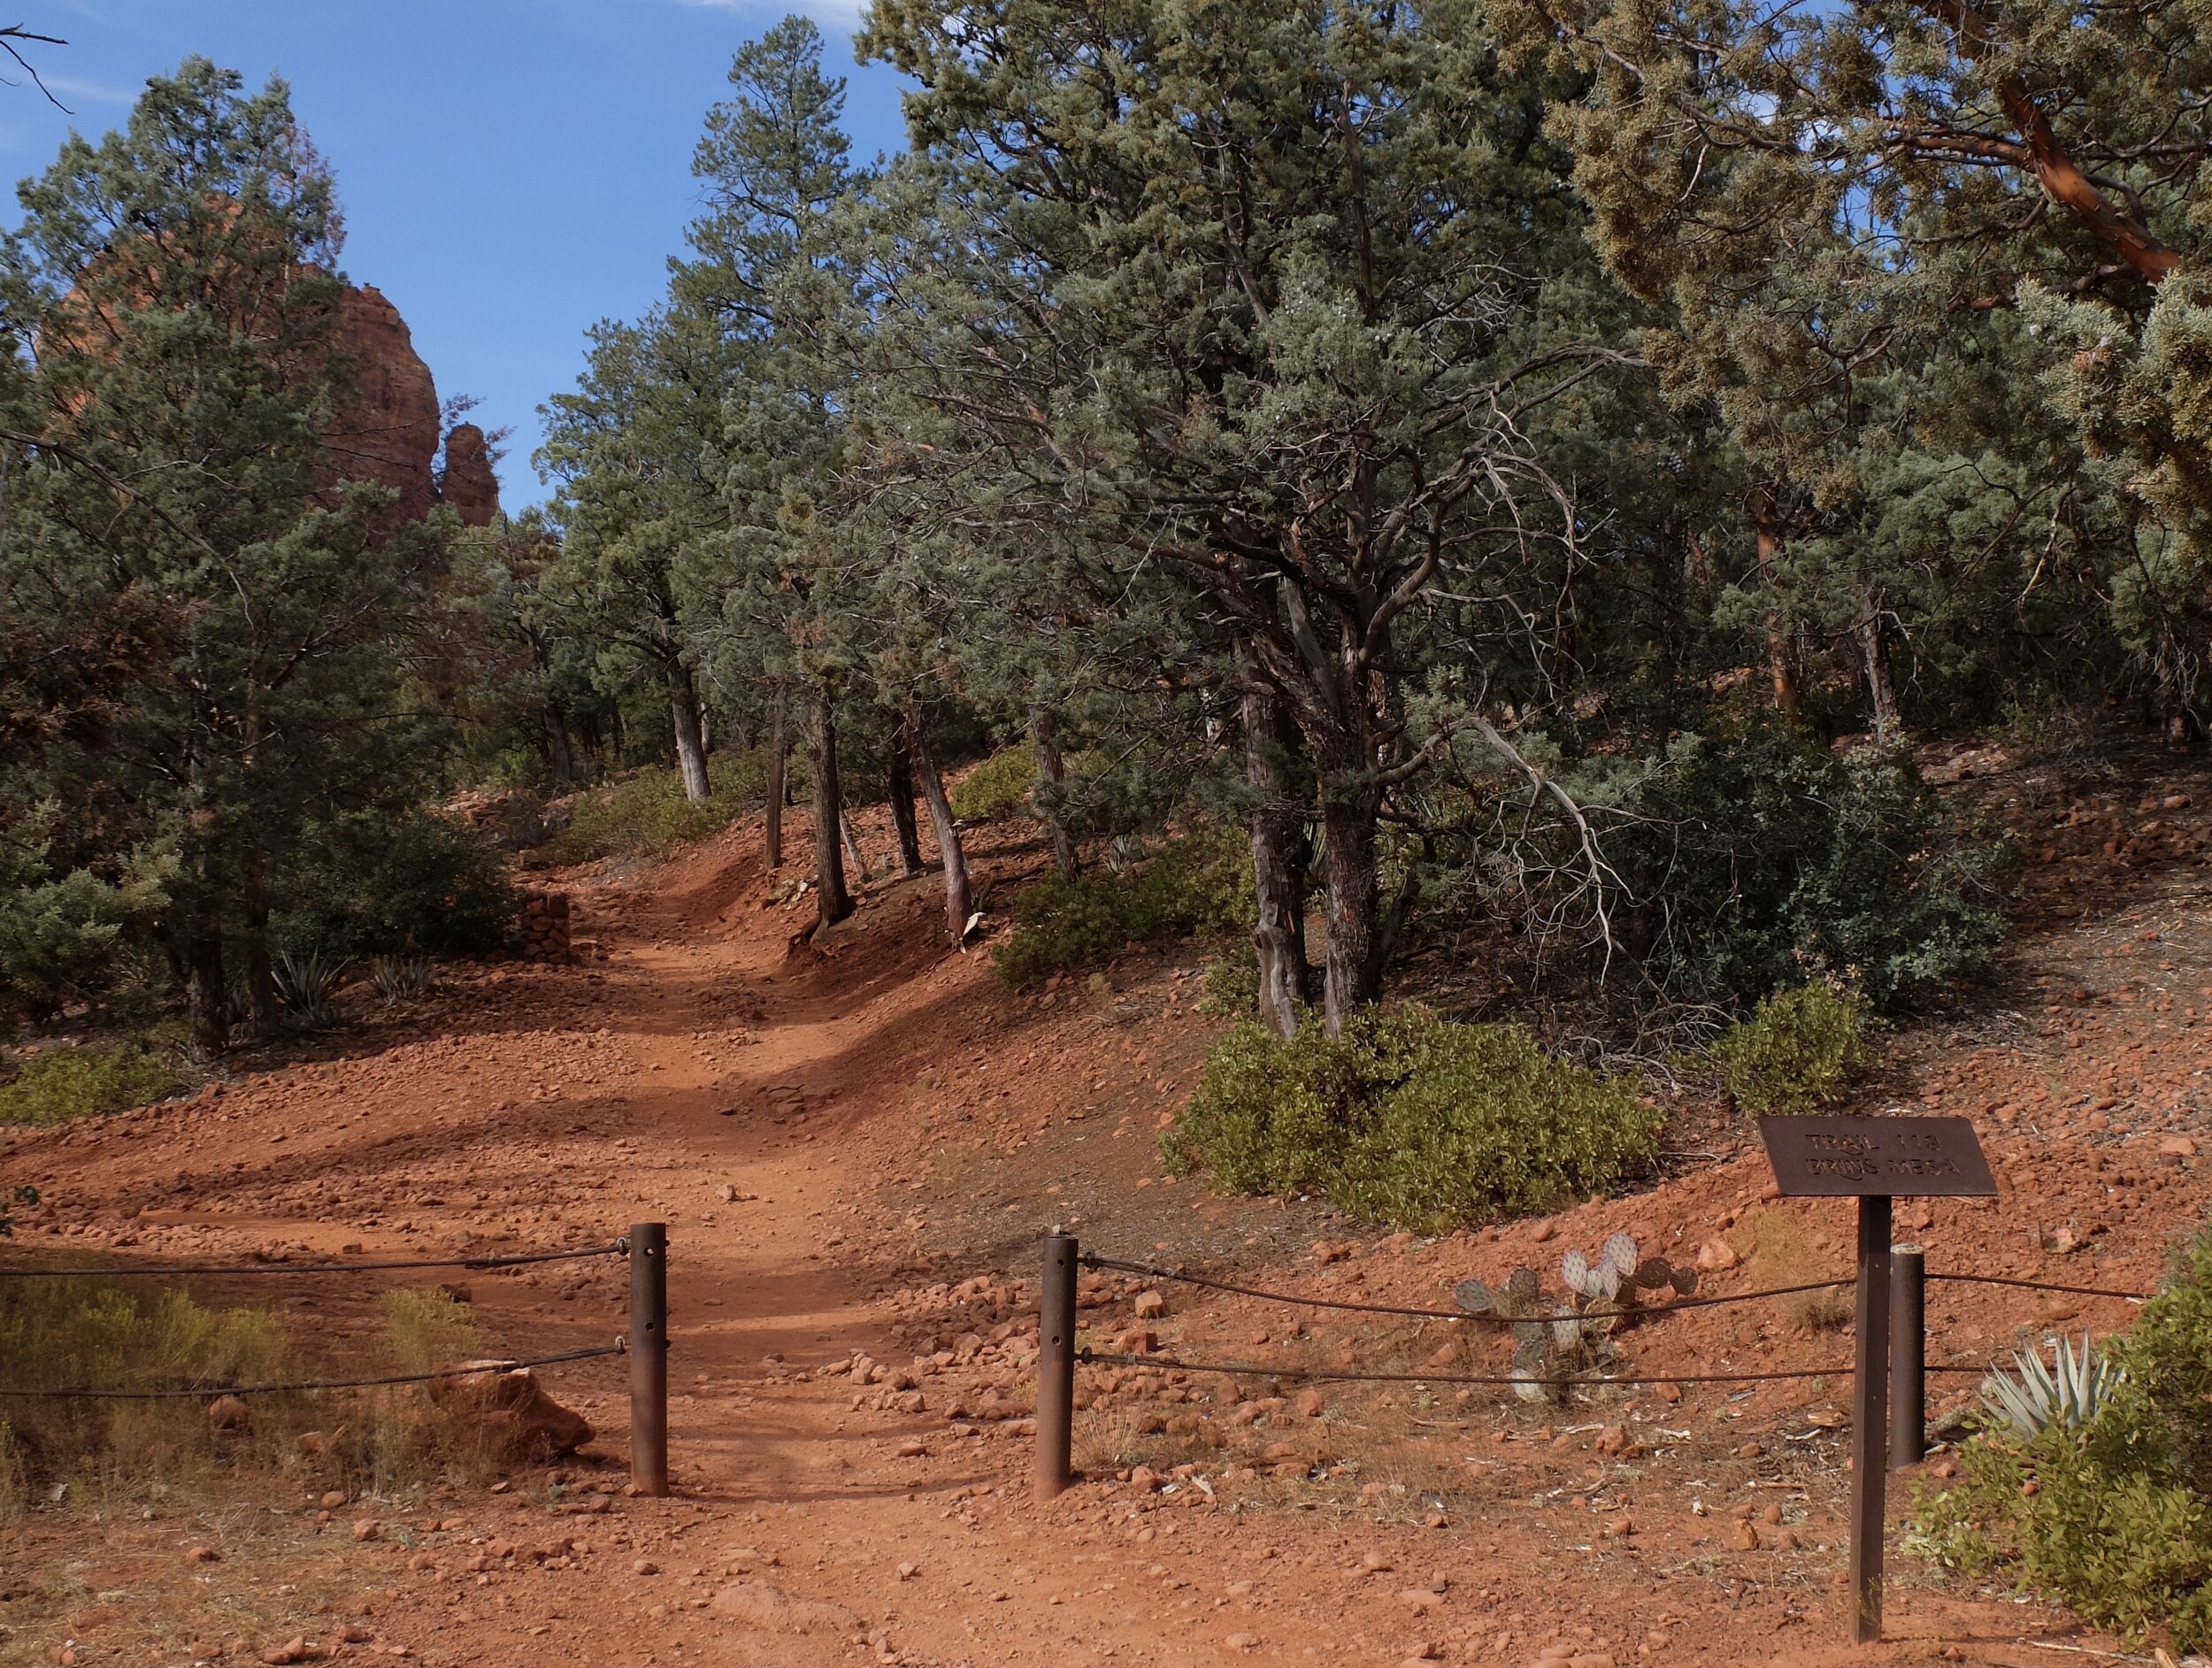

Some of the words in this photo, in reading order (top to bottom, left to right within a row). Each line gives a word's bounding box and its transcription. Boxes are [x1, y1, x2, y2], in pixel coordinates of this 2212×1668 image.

[1805, 1134, 1880, 1156] TRAIL
[1804, 1158, 1879, 1181] BRINS
[1887, 1158, 1962, 1177] MESA
